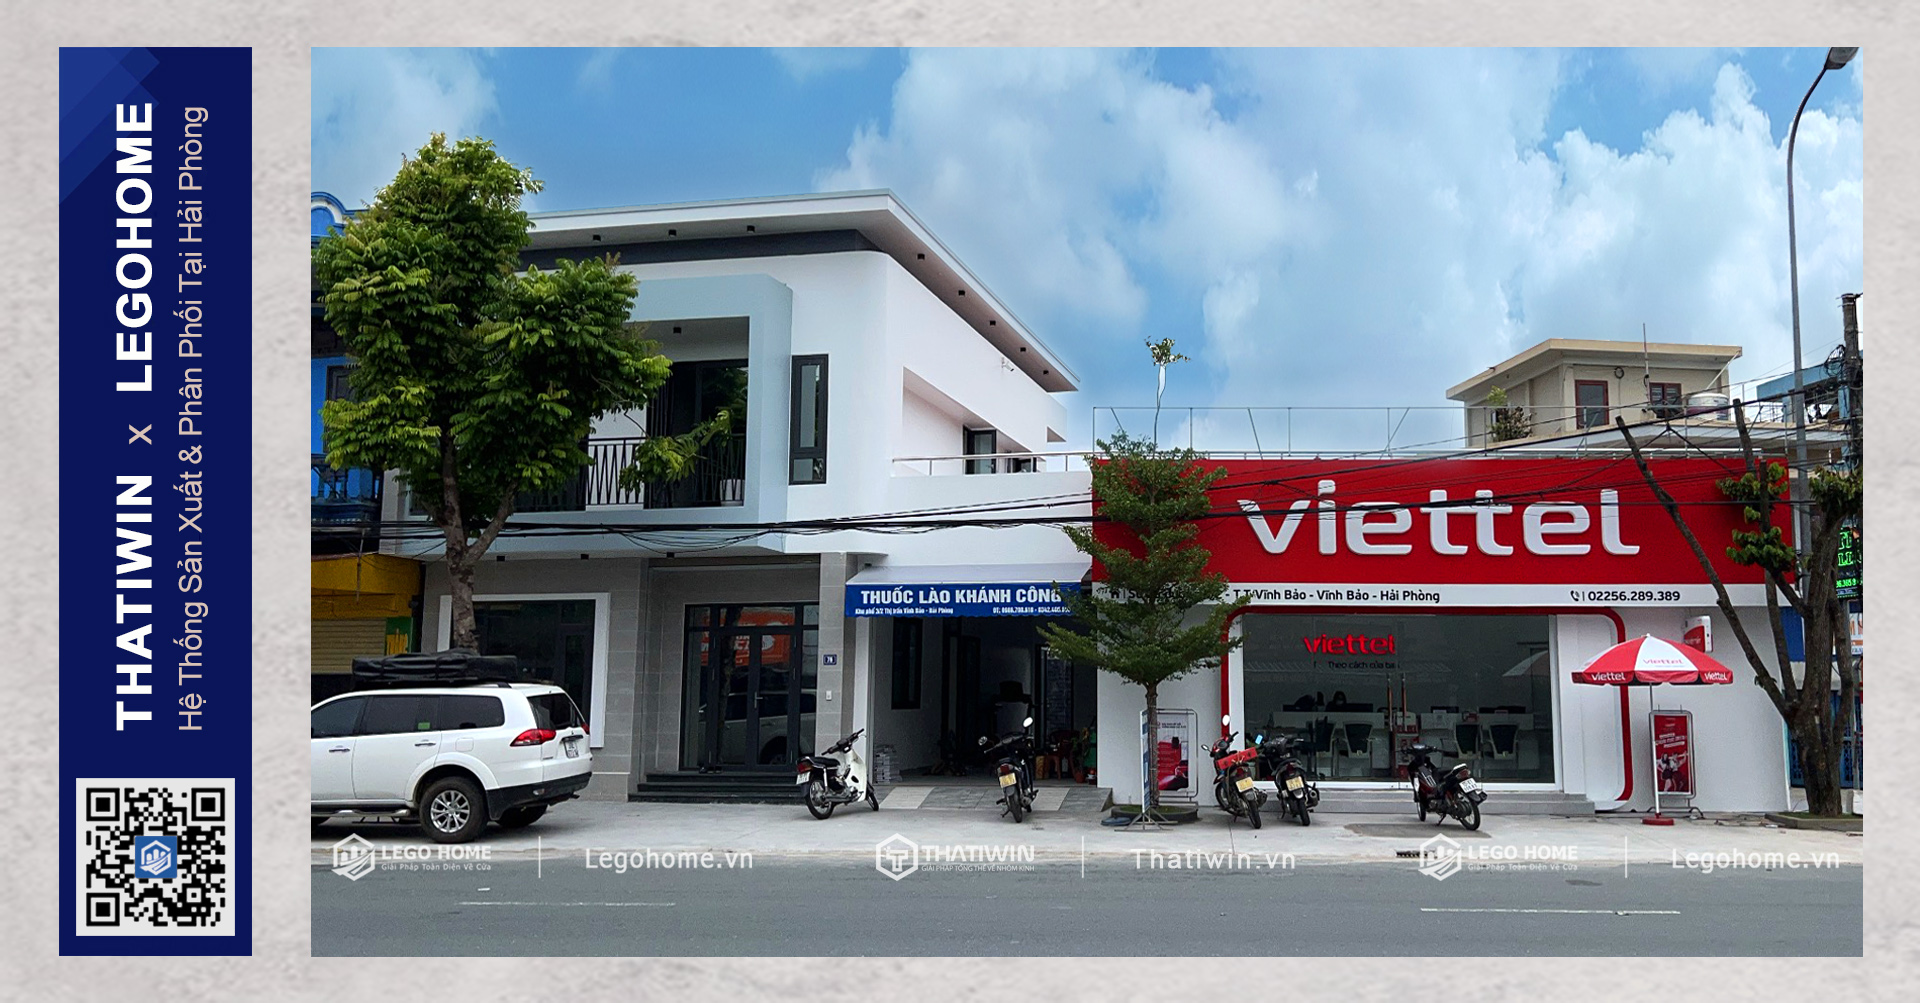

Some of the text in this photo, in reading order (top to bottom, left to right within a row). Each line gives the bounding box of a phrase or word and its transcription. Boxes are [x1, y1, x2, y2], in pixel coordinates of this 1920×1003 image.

[1237, 480, 1640, 555] viettel
[861, 585, 1062, 604] THUỐC LÀO KHÁNH CÔNG
[1255, 588, 1280, 601] Vĩnh
[1284, 588, 1306, 601] Bảo
[1317, 588, 1343, 601] Vĩnh
[1347, 588, 1370, 601] Bảo
[1380, 588, 1399, 601] Hải
[1403, 589, 1440, 604] Phòng
[1588, 590, 1681, 602] 02256.289.389
[1303, 633, 1397, 655] viettel
[1591, 670, 1626, 682] viettel
